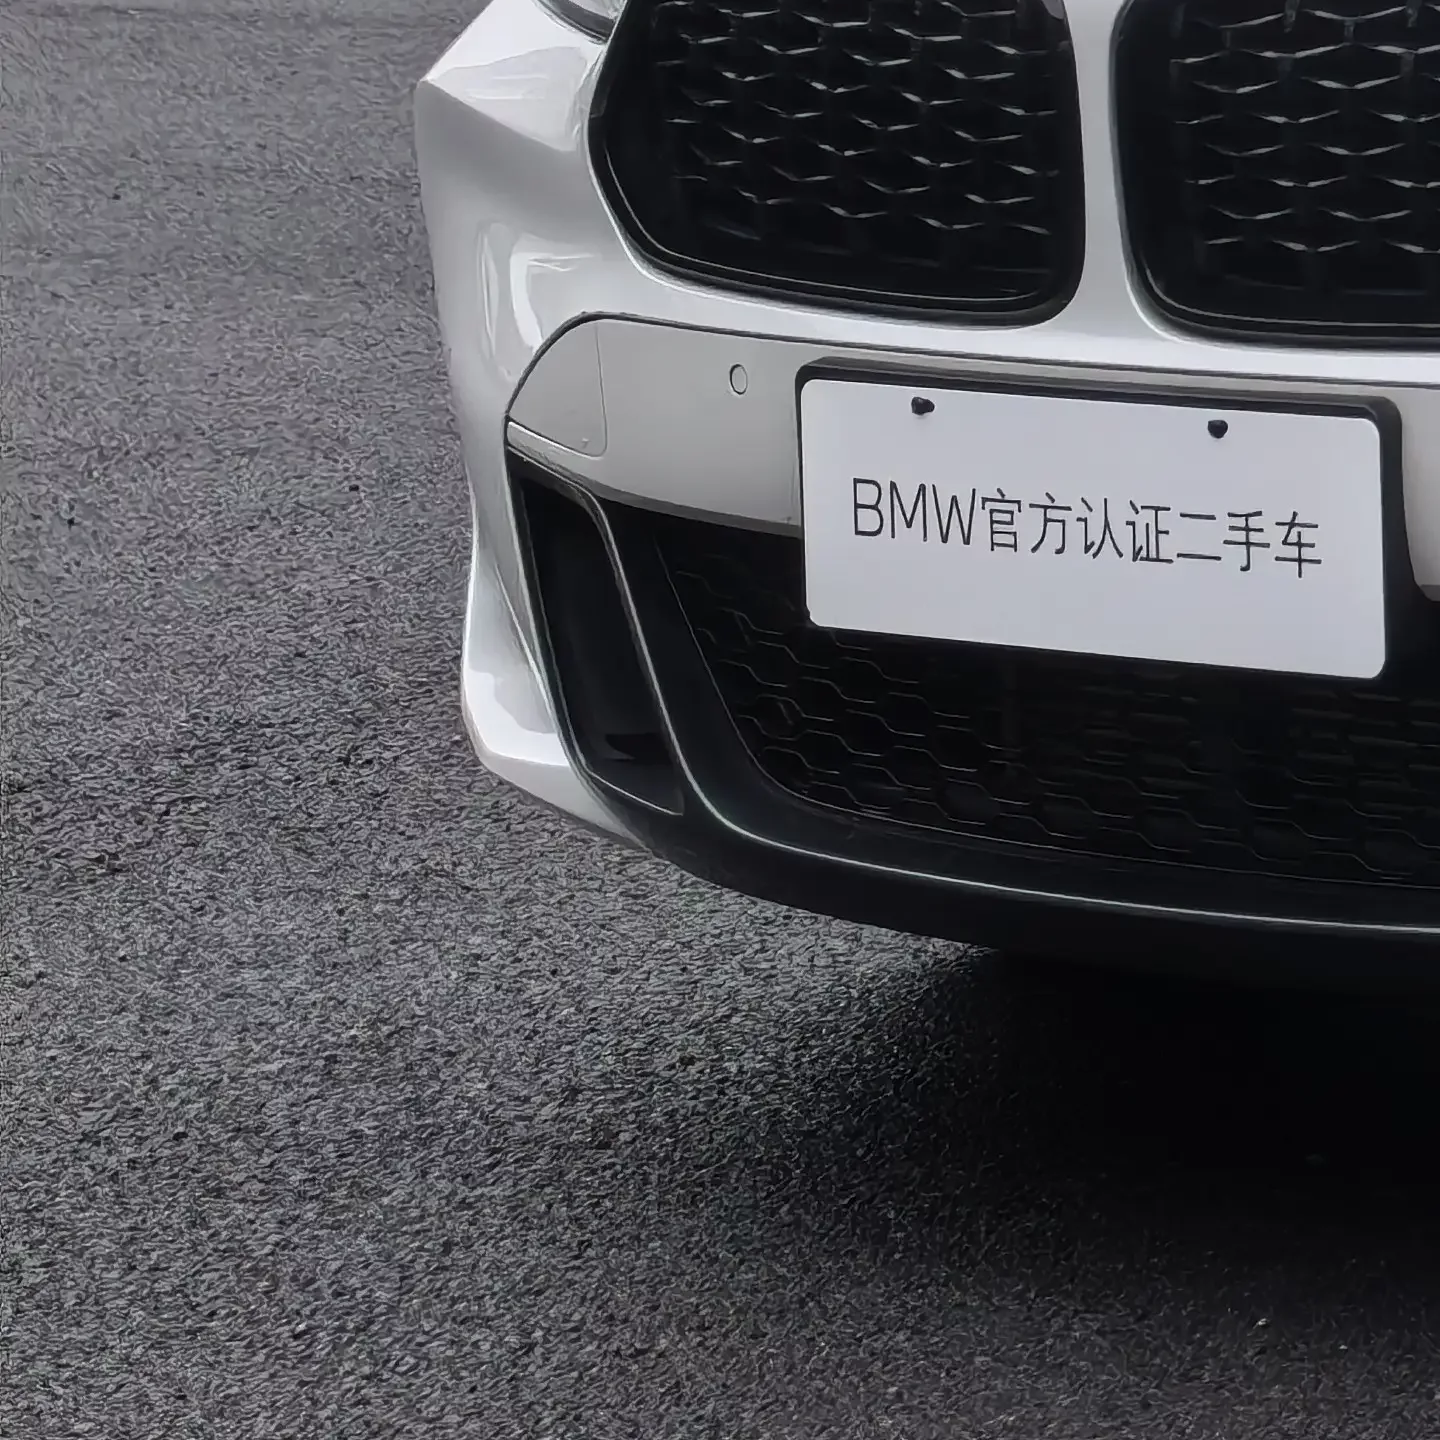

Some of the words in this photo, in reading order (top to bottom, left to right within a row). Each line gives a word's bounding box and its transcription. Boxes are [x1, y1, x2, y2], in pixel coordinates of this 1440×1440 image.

[852, 476, 1323, 579] BMW官方认证二手车
